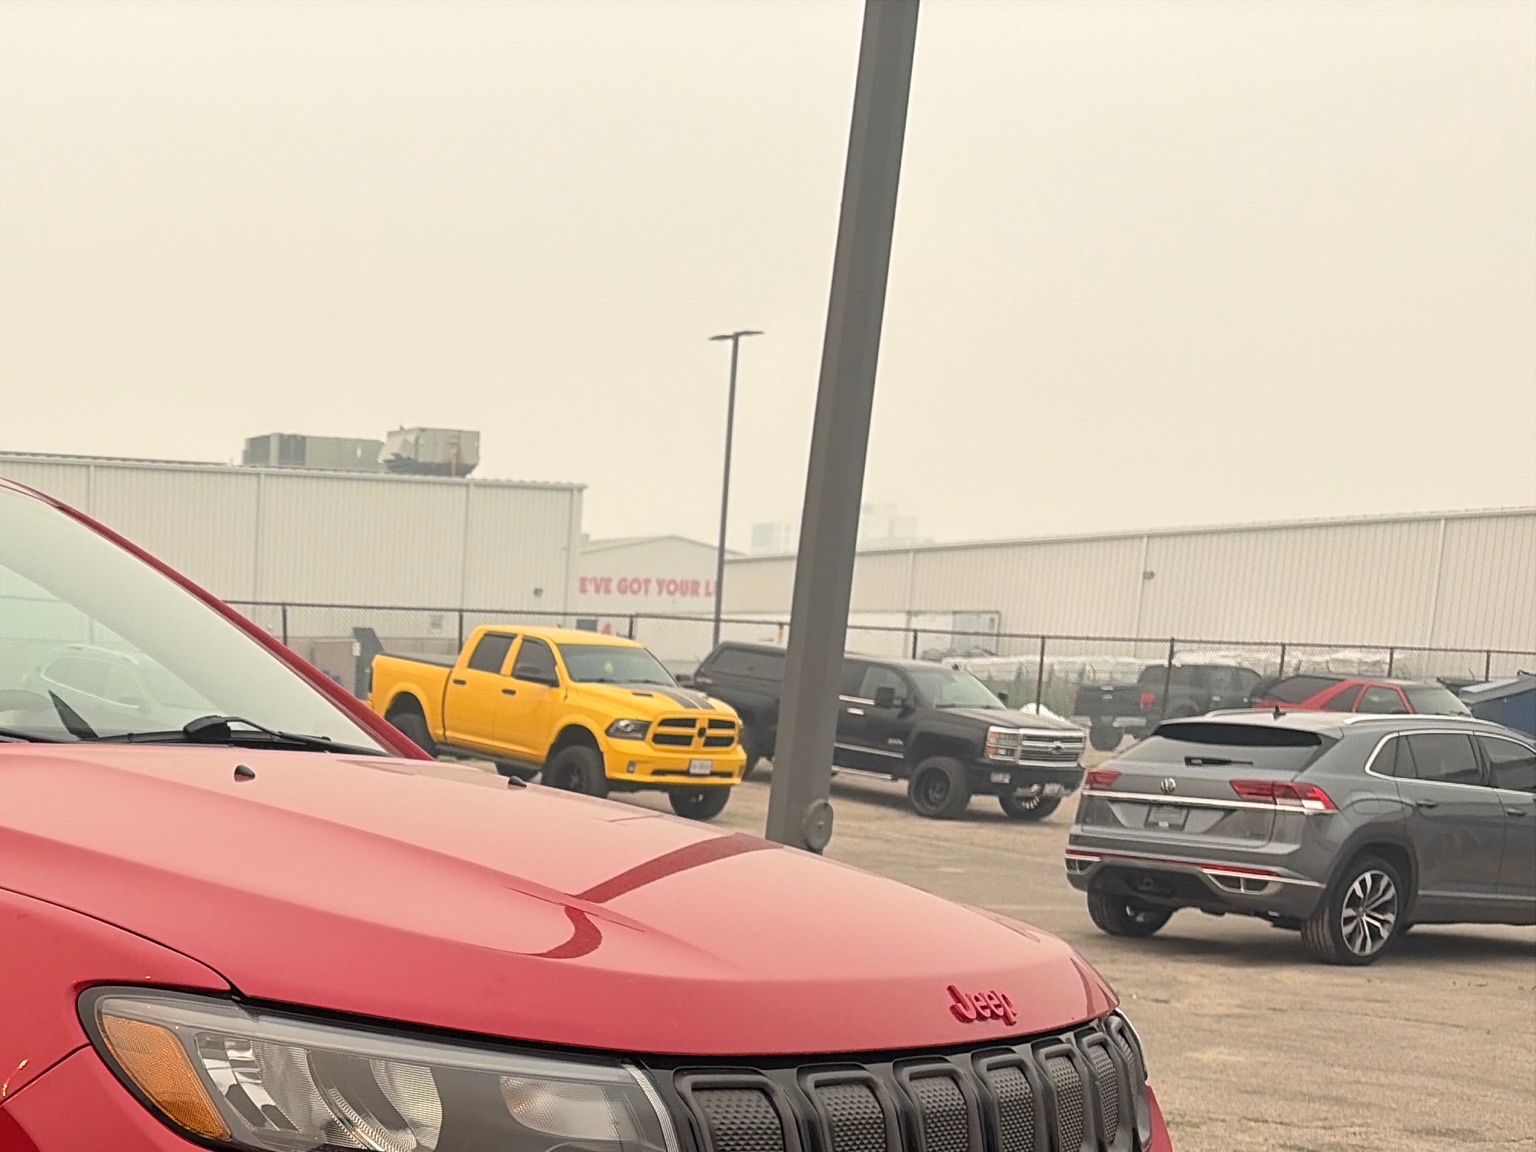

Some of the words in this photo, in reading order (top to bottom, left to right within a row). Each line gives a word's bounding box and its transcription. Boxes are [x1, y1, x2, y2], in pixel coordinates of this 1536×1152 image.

[617, 577, 651, 596] GOT
[656, 578, 700, 597] YOUR
[946, 985, 1017, 1026] Jeep
